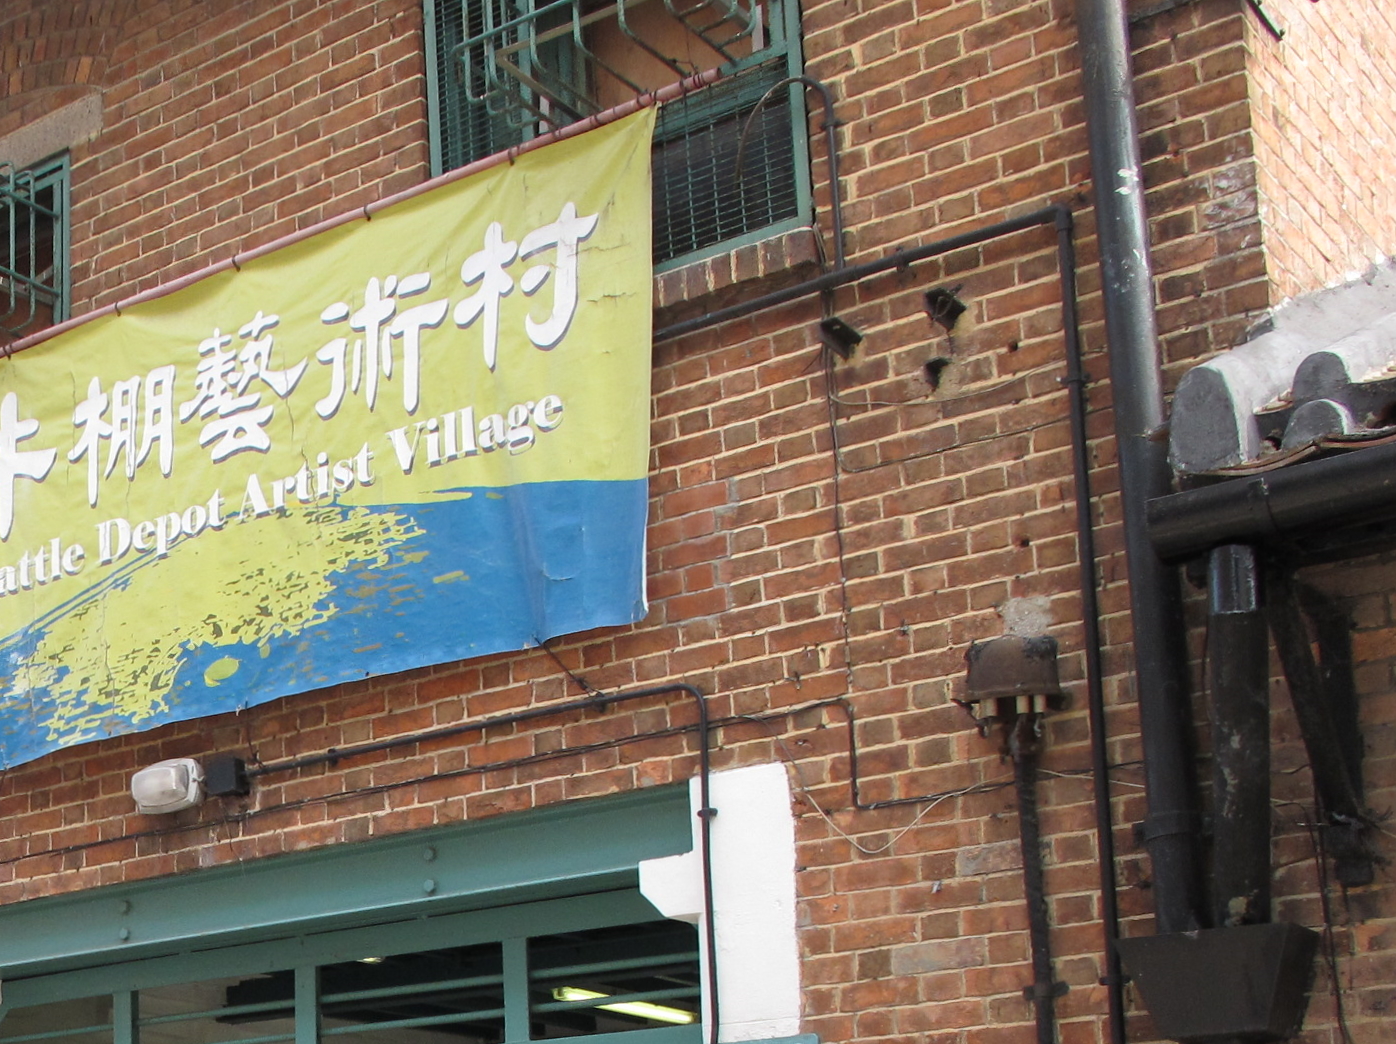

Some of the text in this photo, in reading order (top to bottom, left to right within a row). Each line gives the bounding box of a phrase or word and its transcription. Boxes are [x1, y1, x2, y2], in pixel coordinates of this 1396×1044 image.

[96, 489, 226, 567] Depot
[234, 444, 375, 520] Artist
[386, 393, 564, 476] Village
